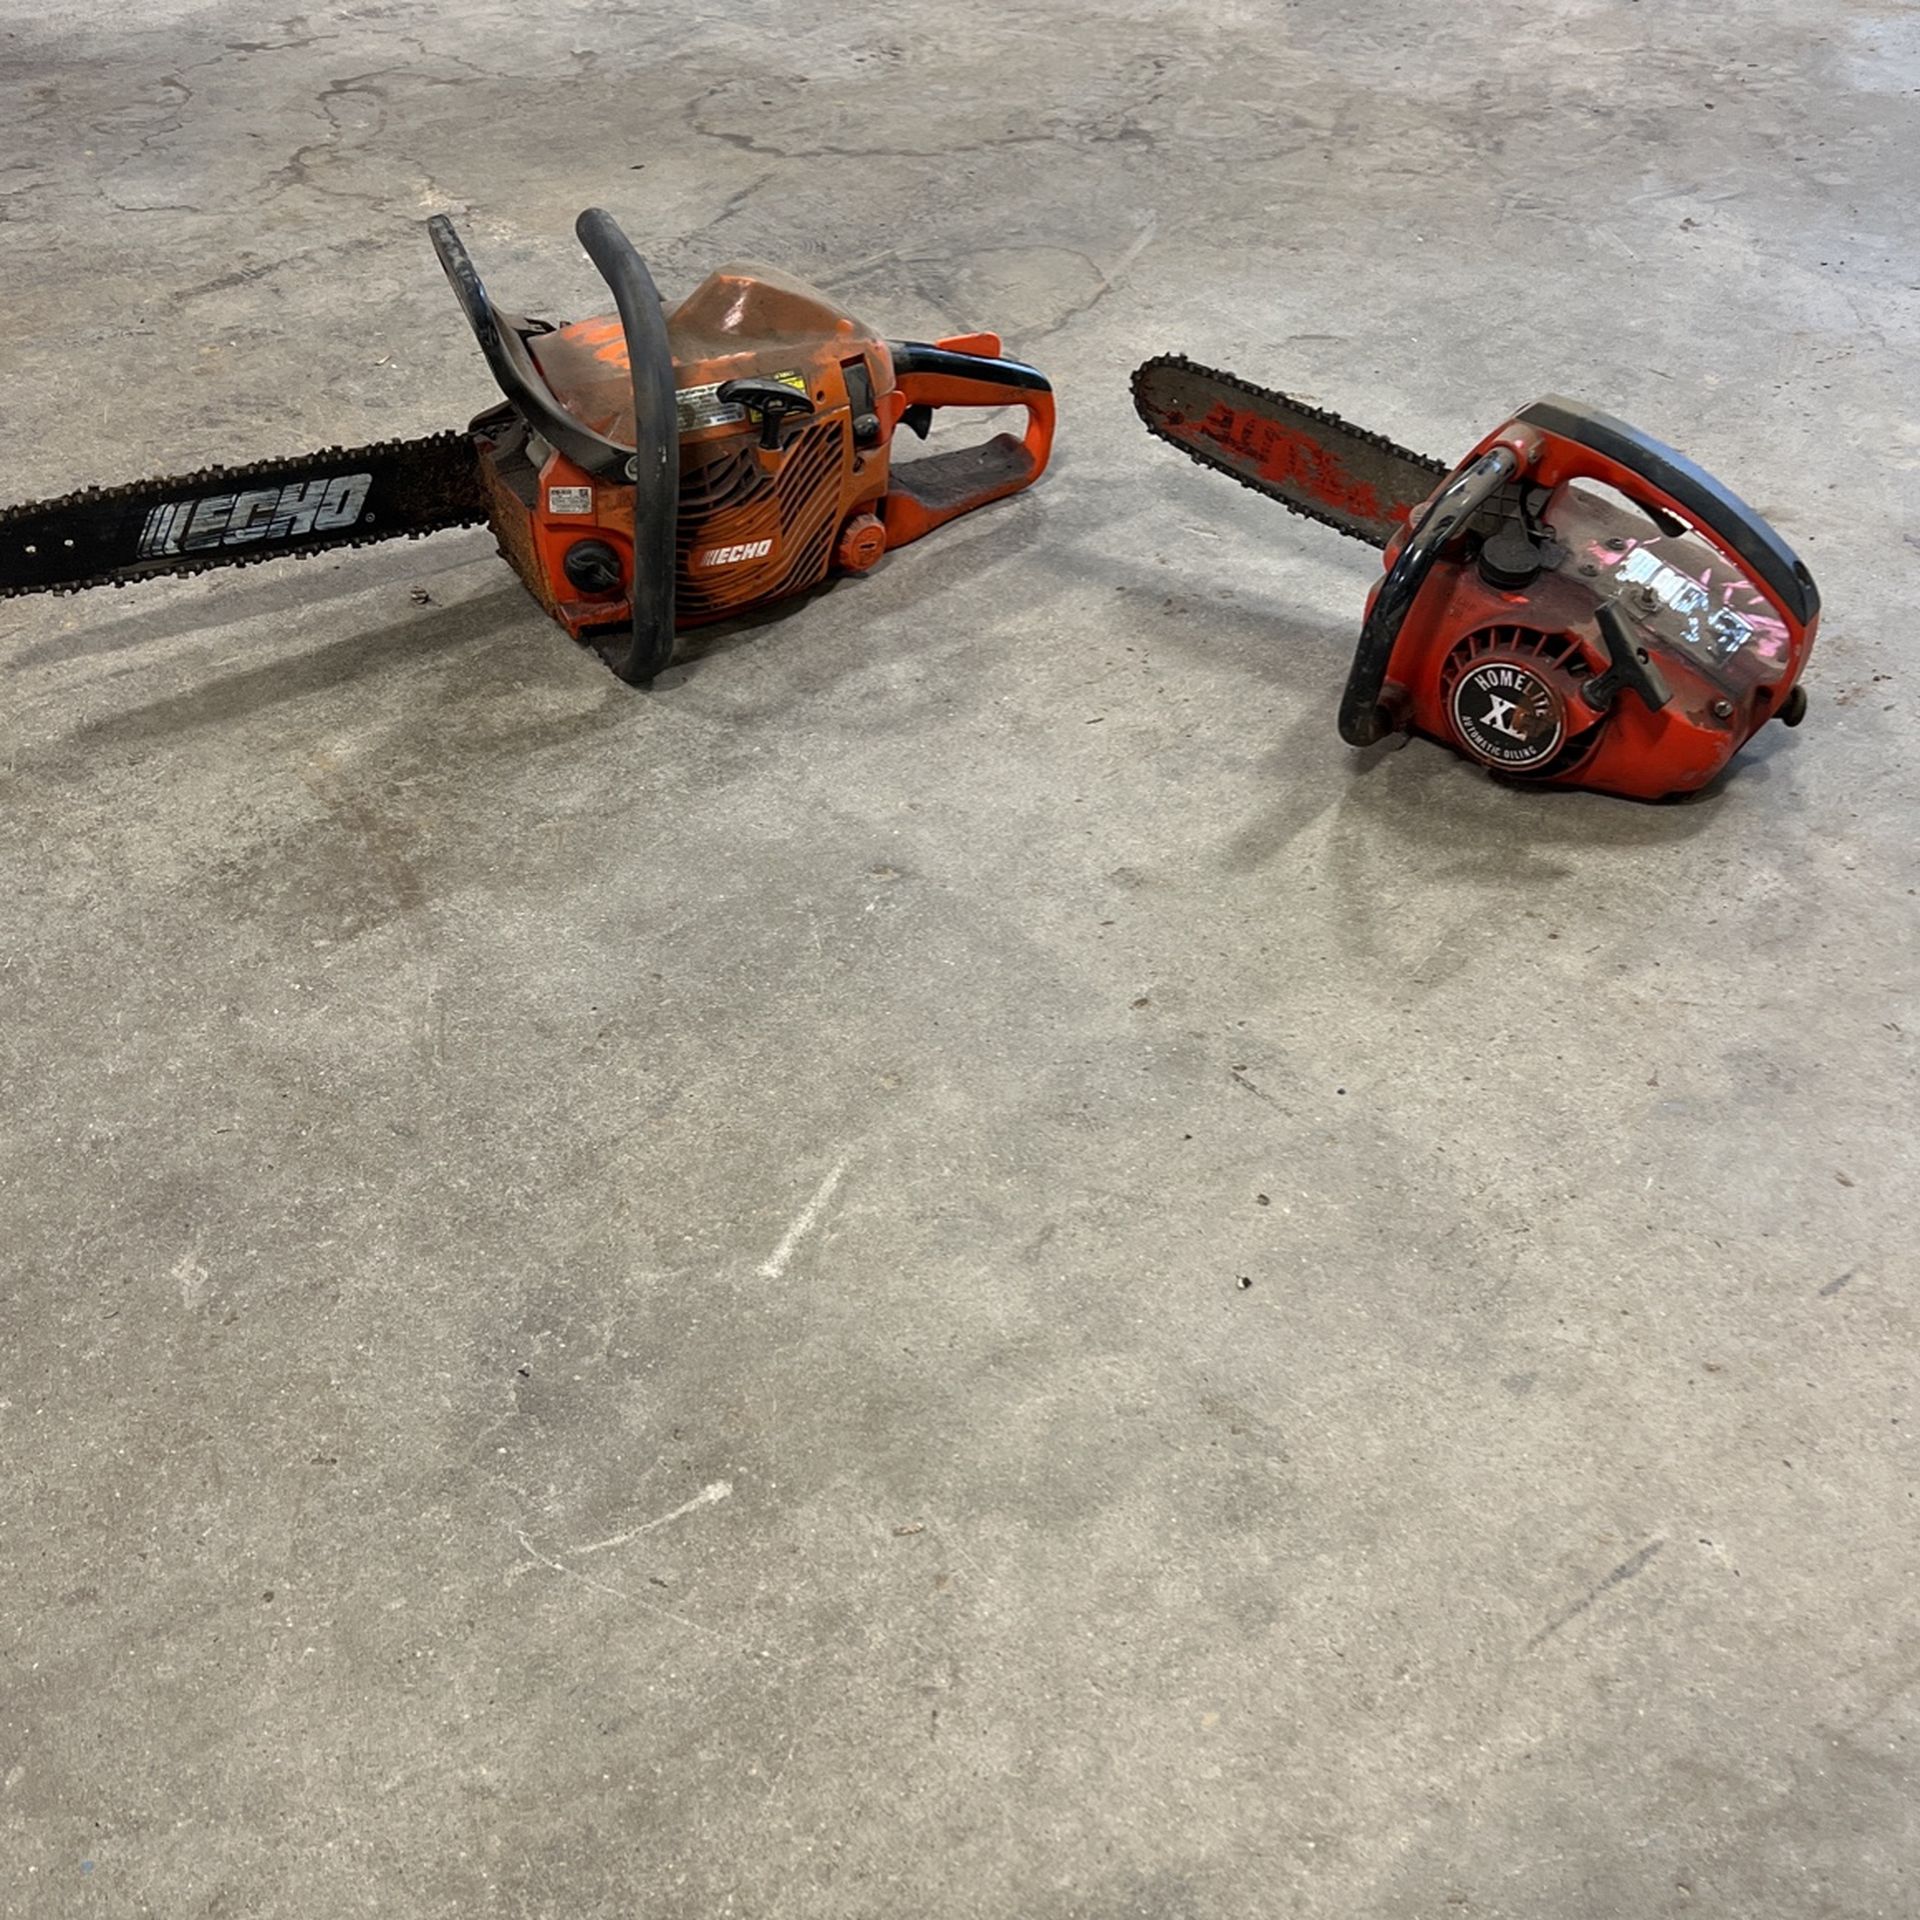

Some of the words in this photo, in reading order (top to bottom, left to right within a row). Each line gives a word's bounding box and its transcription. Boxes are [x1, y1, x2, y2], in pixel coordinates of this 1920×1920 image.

[181, 473, 372, 551] ECHO
[716, 539, 773, 565] ECHO
[1462, 715, 1501, 756] AUTOMATIC
[1504, 746, 1537, 759] OILING
